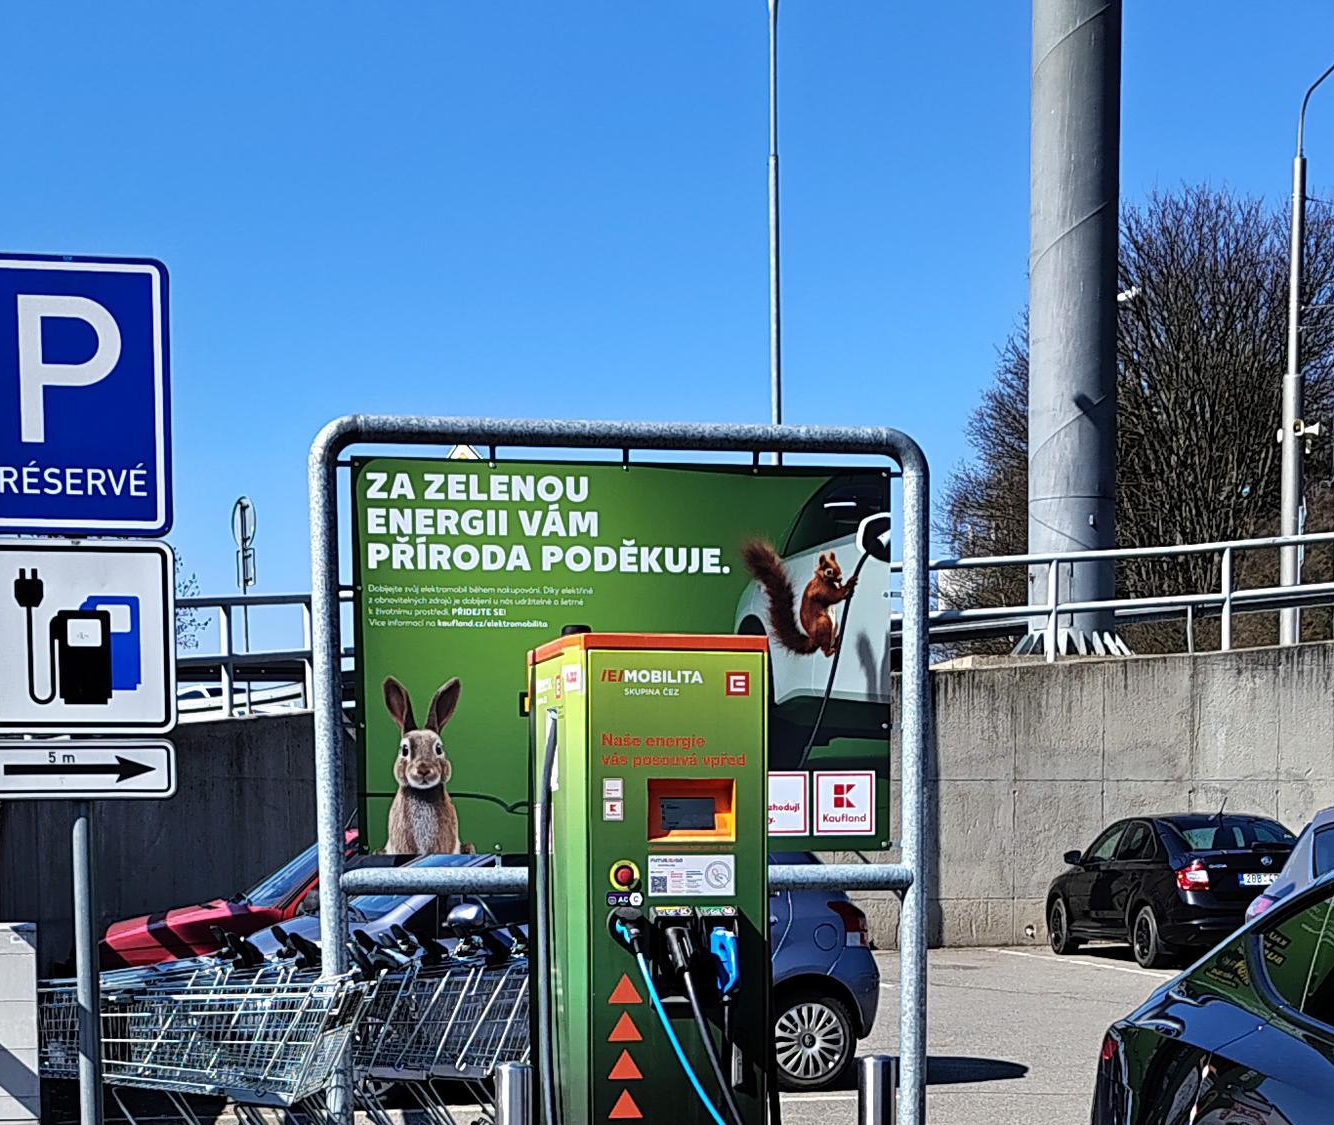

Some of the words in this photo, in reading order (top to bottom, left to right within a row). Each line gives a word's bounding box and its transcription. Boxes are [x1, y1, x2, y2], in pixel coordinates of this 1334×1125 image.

[17, 294, 122, 443] P
[366, 472, 415, 500] ZA
[424, 473, 589, 502] ZELENOU
[367, 507, 508, 537] ENERGII
[518, 504, 599, 537] VÁM
[367, 535, 531, 572] PŘÍRODA
[542, 538, 731, 575] PODĚKUJE.
[437, 619, 548, 628] kaufland.cz/elektromobilita
[623, 688, 661, 696] SKUPINA
[662, 686, 680, 696] ČEZ
[601, 732, 641, 747] Naše
[645, 734, 706, 750] energie
[48, 751, 56, 764] 5
[62, 754, 75, 763] m
[601, 752, 628, 765] vás
[633, 753, 698, 768] posouvá
[702, 752, 746, 768] vpřed
[823, 813, 866, 823] Kaufland
